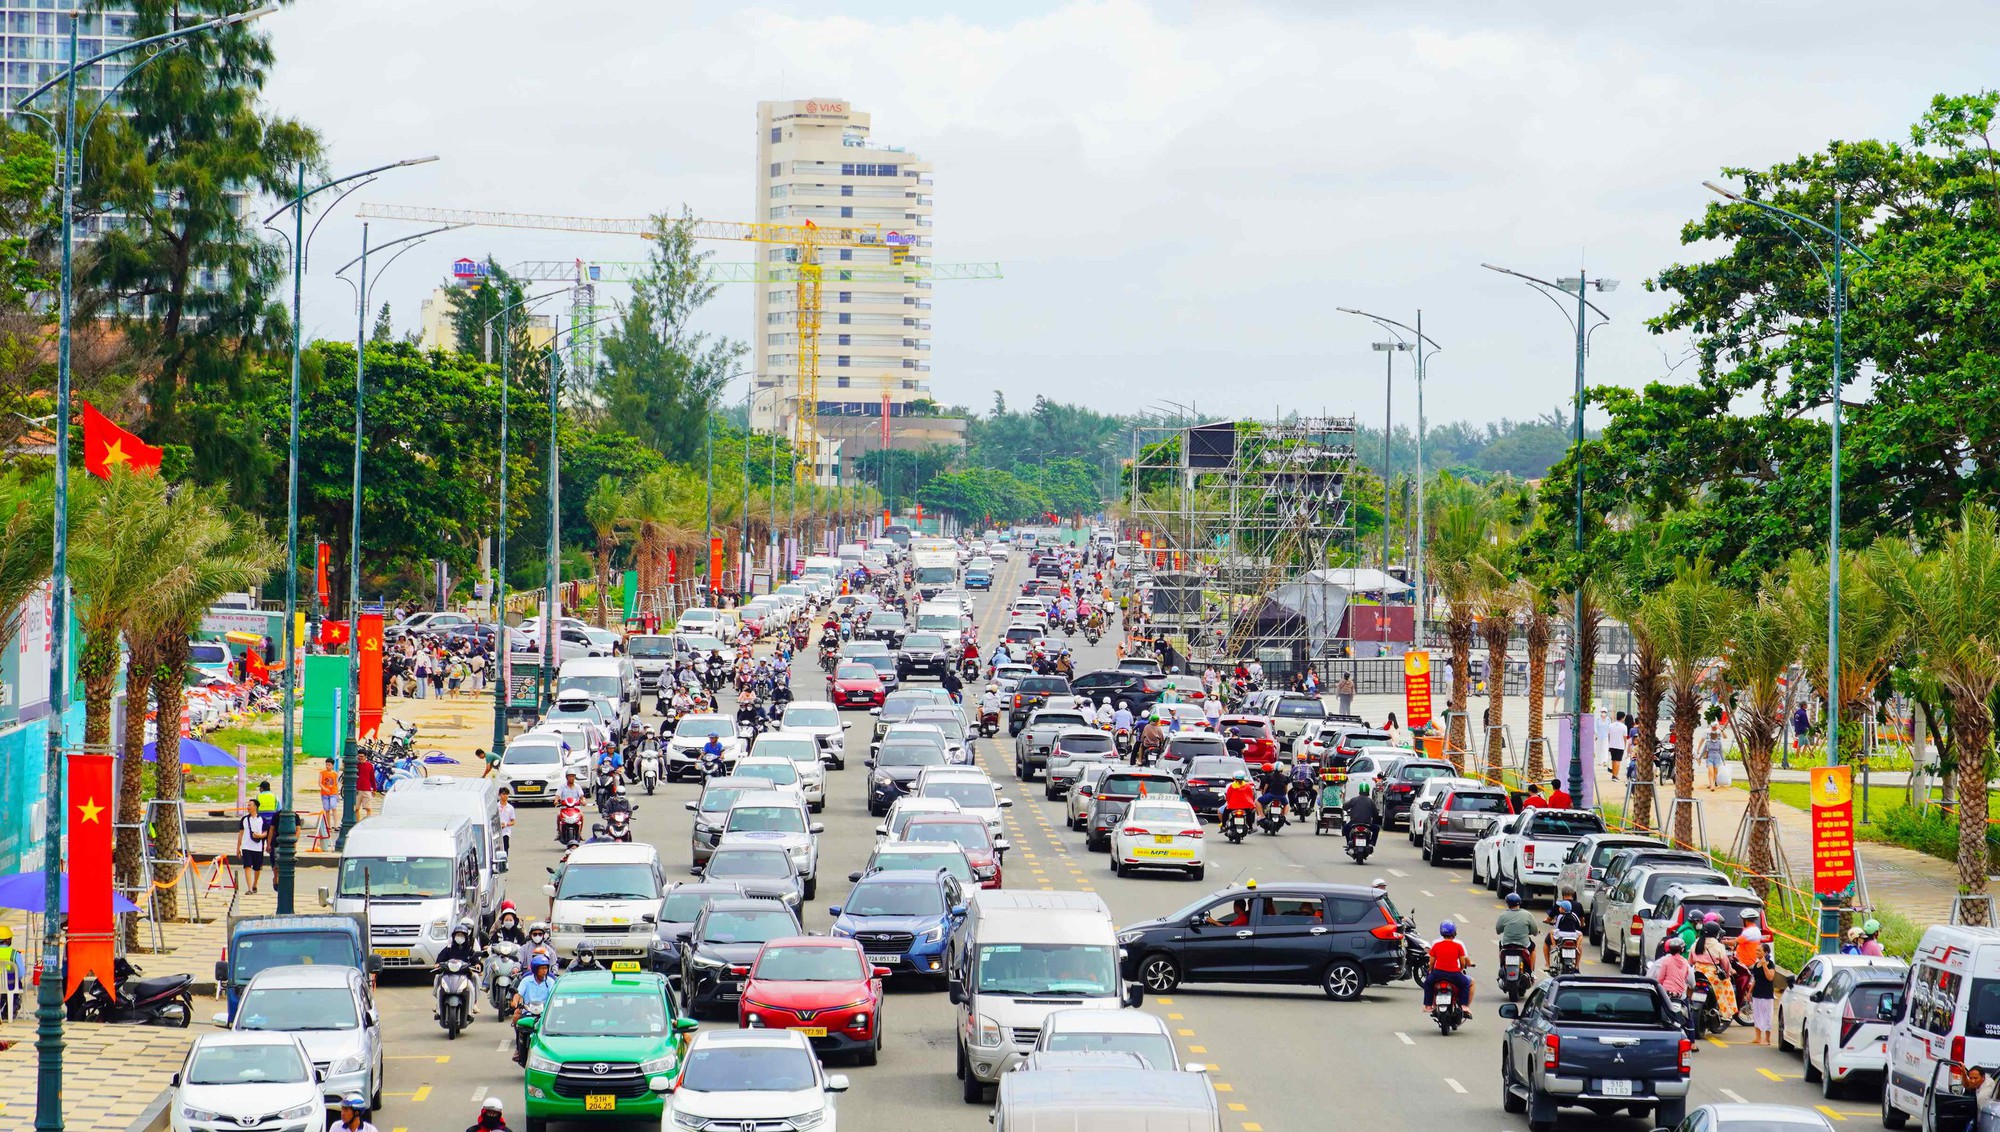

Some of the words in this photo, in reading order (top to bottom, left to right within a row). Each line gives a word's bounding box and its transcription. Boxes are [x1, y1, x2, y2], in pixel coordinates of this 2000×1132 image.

[819, 103, 842, 112] VIAS
[594, 1095, 607, 1103] 51H
[589, 1102, 612, 1110] 204.25
